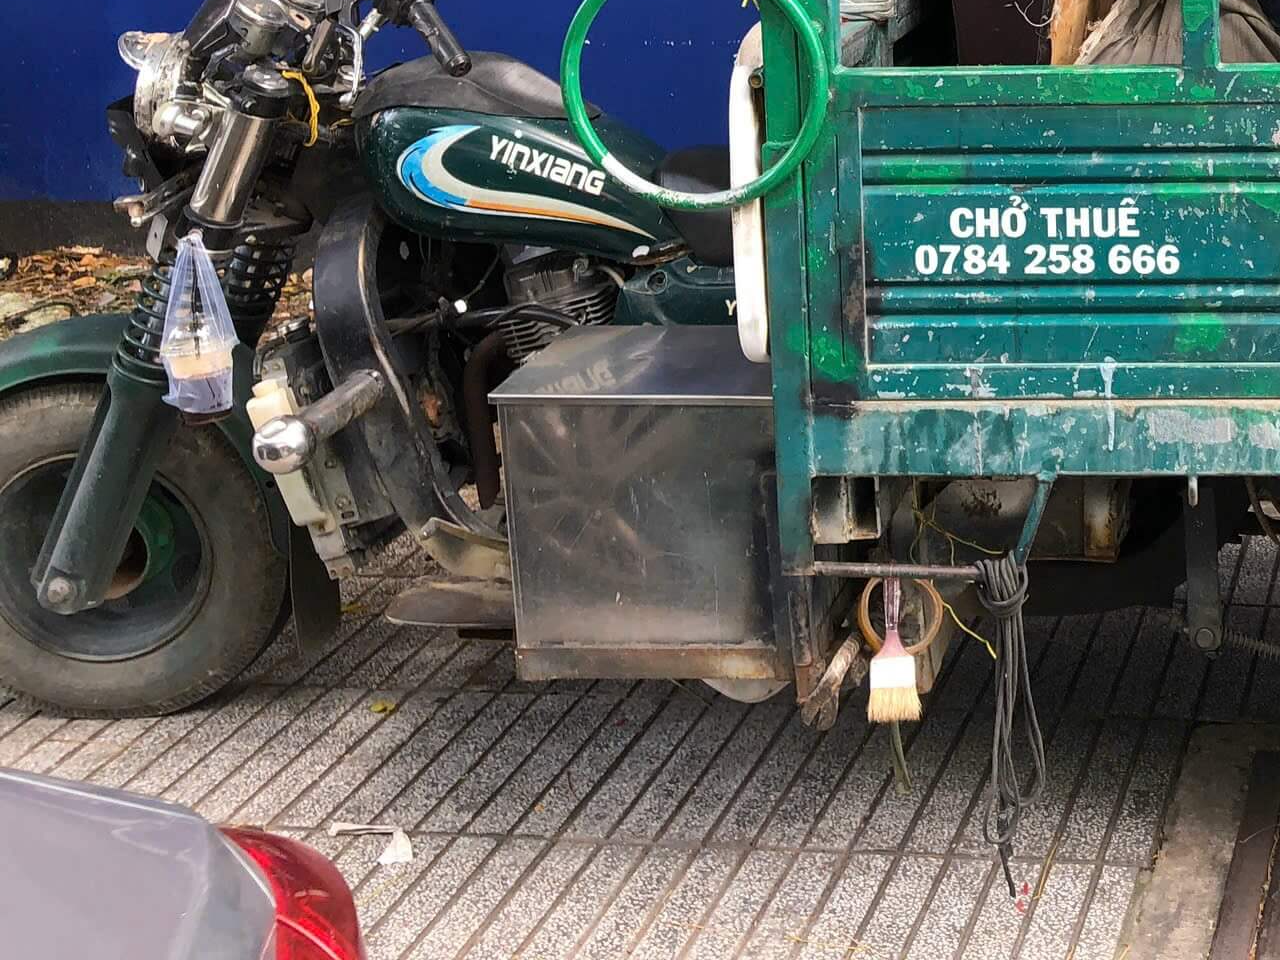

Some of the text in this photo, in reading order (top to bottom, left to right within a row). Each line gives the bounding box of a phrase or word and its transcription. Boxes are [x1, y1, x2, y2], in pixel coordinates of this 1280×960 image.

[949, 195, 1140, 239] CHỞ THUÊ
[914, 244, 1180, 275] 0784 258 666
